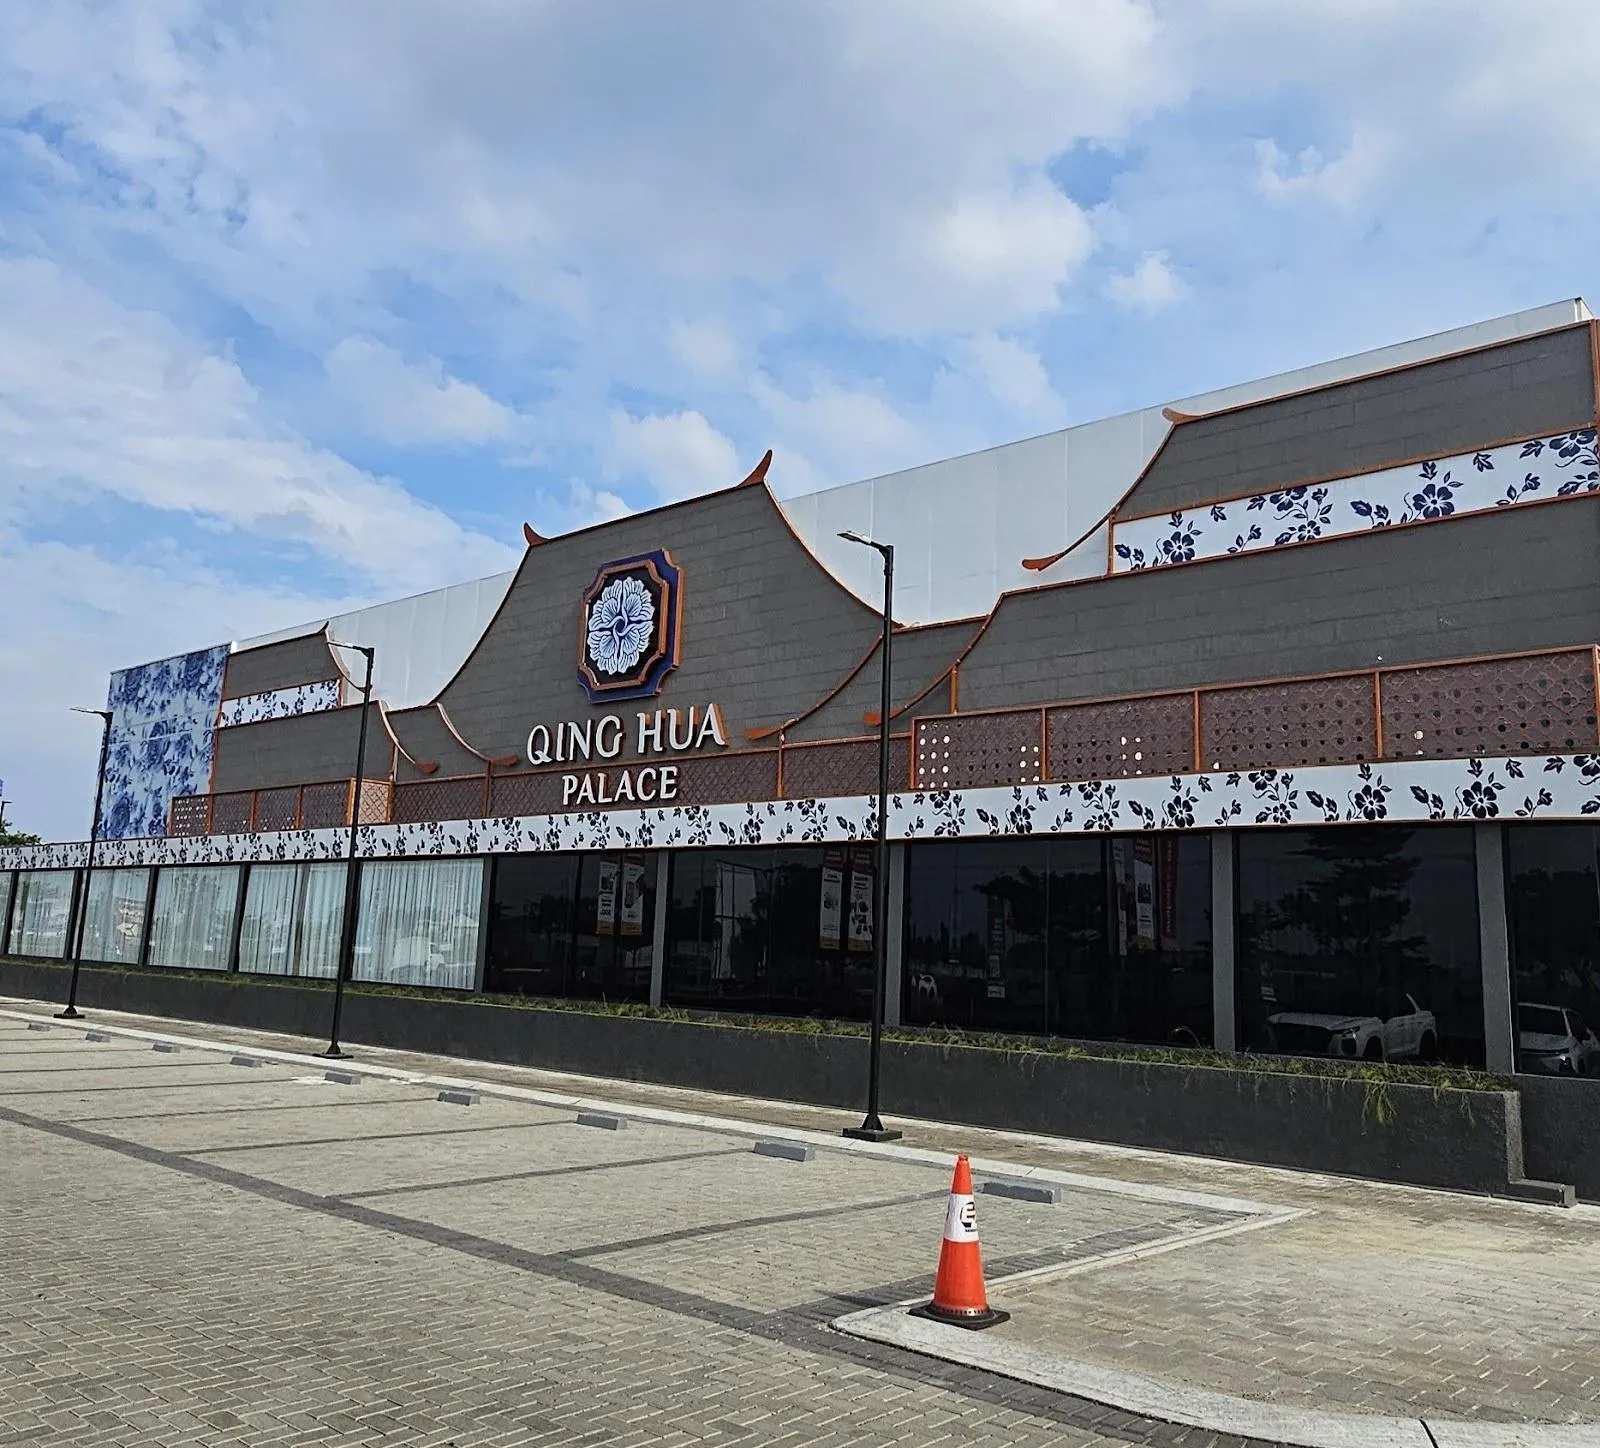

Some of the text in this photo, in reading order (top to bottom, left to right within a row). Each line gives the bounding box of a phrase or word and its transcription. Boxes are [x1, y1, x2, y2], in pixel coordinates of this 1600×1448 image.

[526, 703, 728, 766] QING HUA
[561, 766, 679, 806] PALACE
